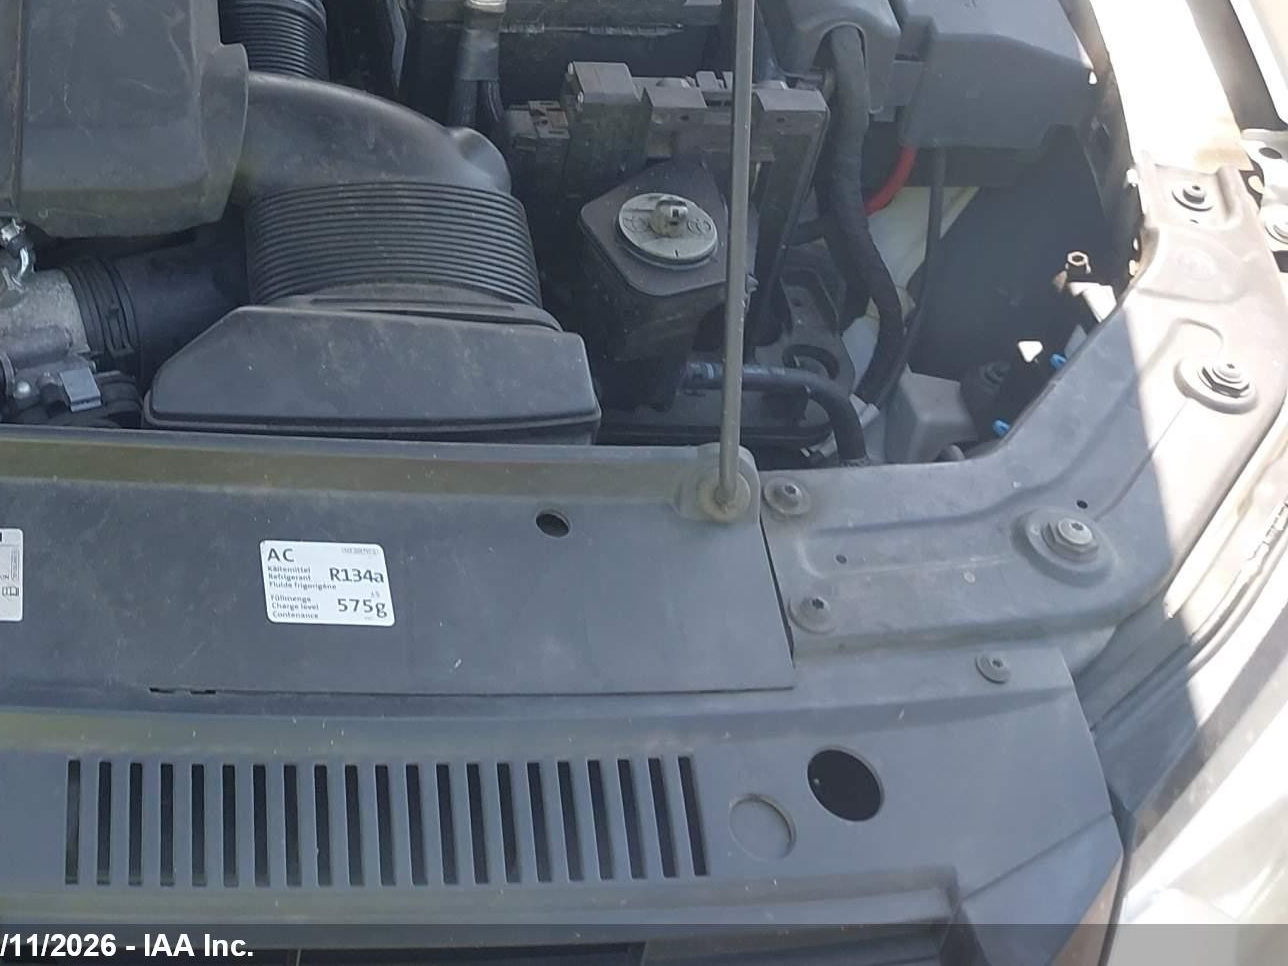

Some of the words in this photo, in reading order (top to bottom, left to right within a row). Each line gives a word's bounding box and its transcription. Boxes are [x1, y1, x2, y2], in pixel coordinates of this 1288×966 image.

[267, 548, 294, 562] AC
[268, 573, 311, 581] Refrigerant
[329, 567, 385, 583] R134a
[272, 602, 299, 611] Charge
[273, 611, 319, 619] Contenance
